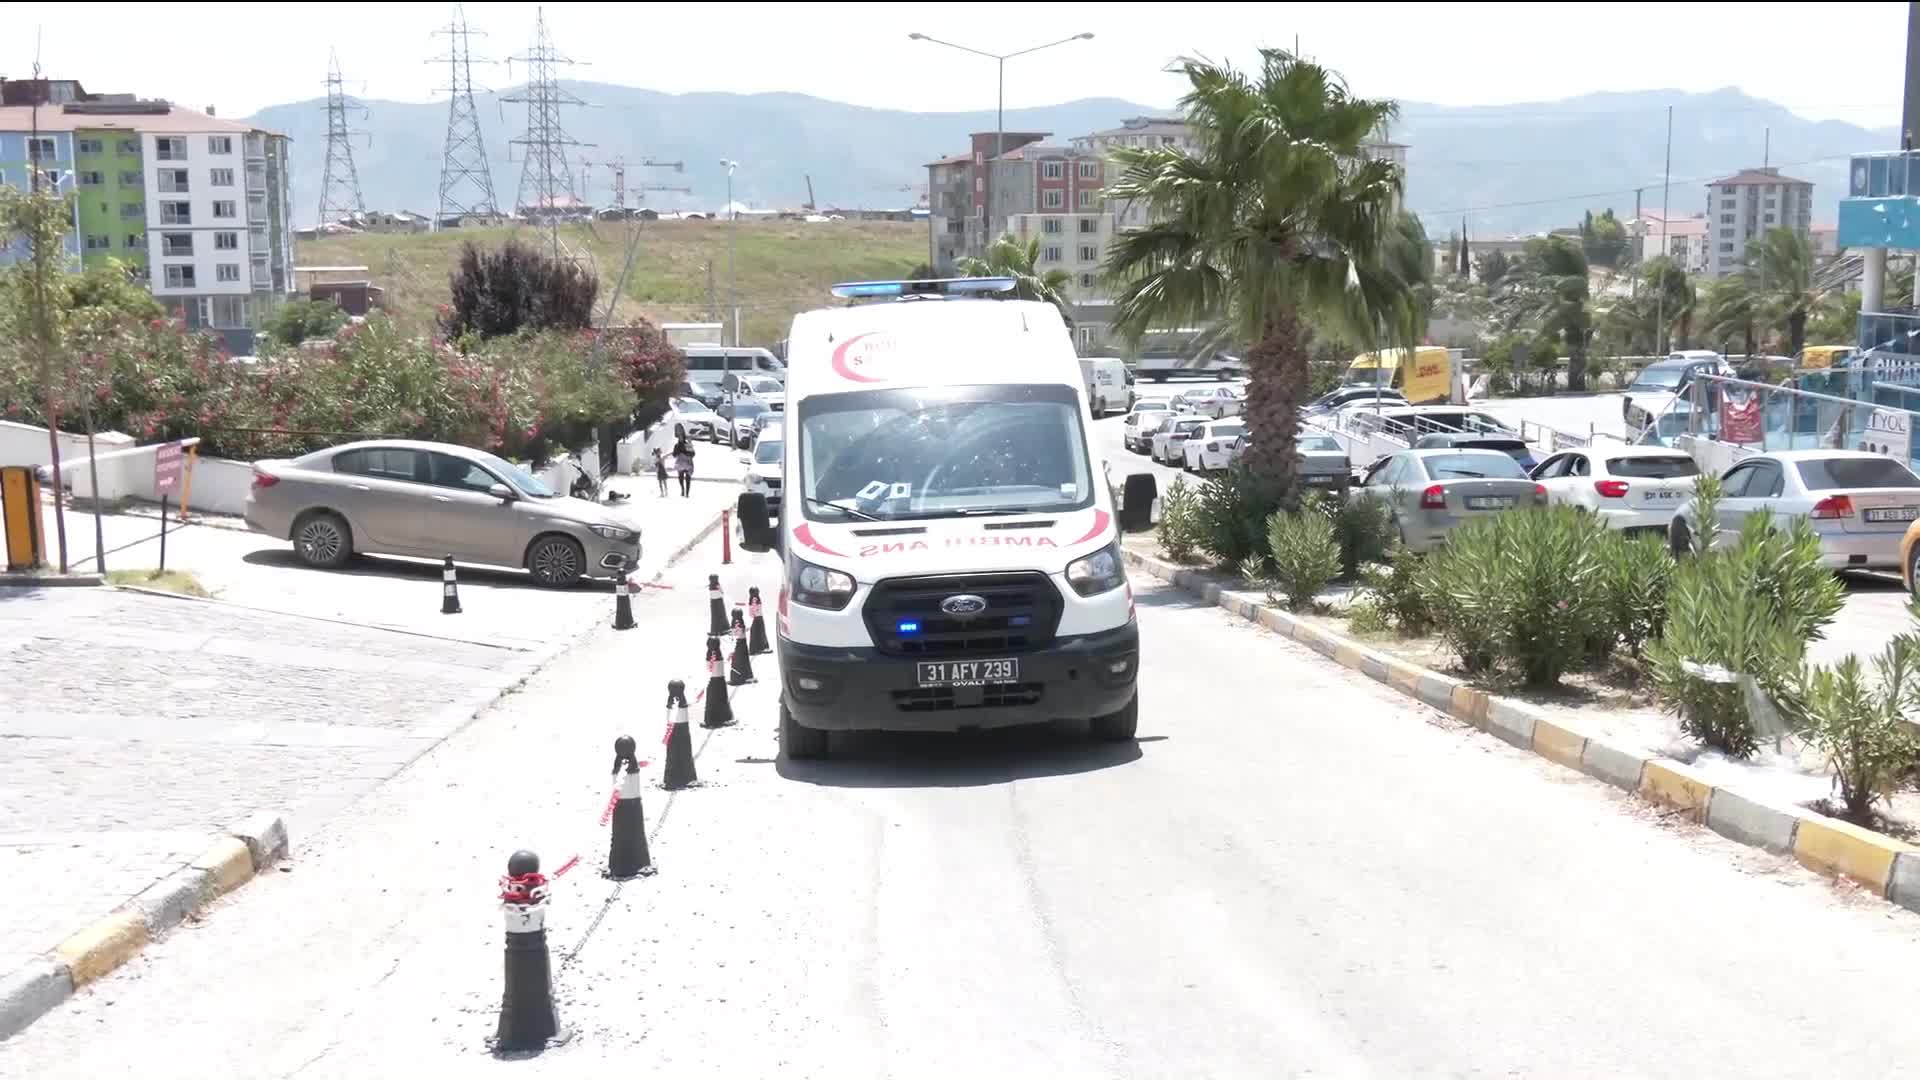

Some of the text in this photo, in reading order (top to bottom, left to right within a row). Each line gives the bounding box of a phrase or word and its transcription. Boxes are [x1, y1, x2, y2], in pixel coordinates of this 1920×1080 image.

[951, 600, 977, 612] Ford
[927, 661, 1012, 681] 31 AFY 239
